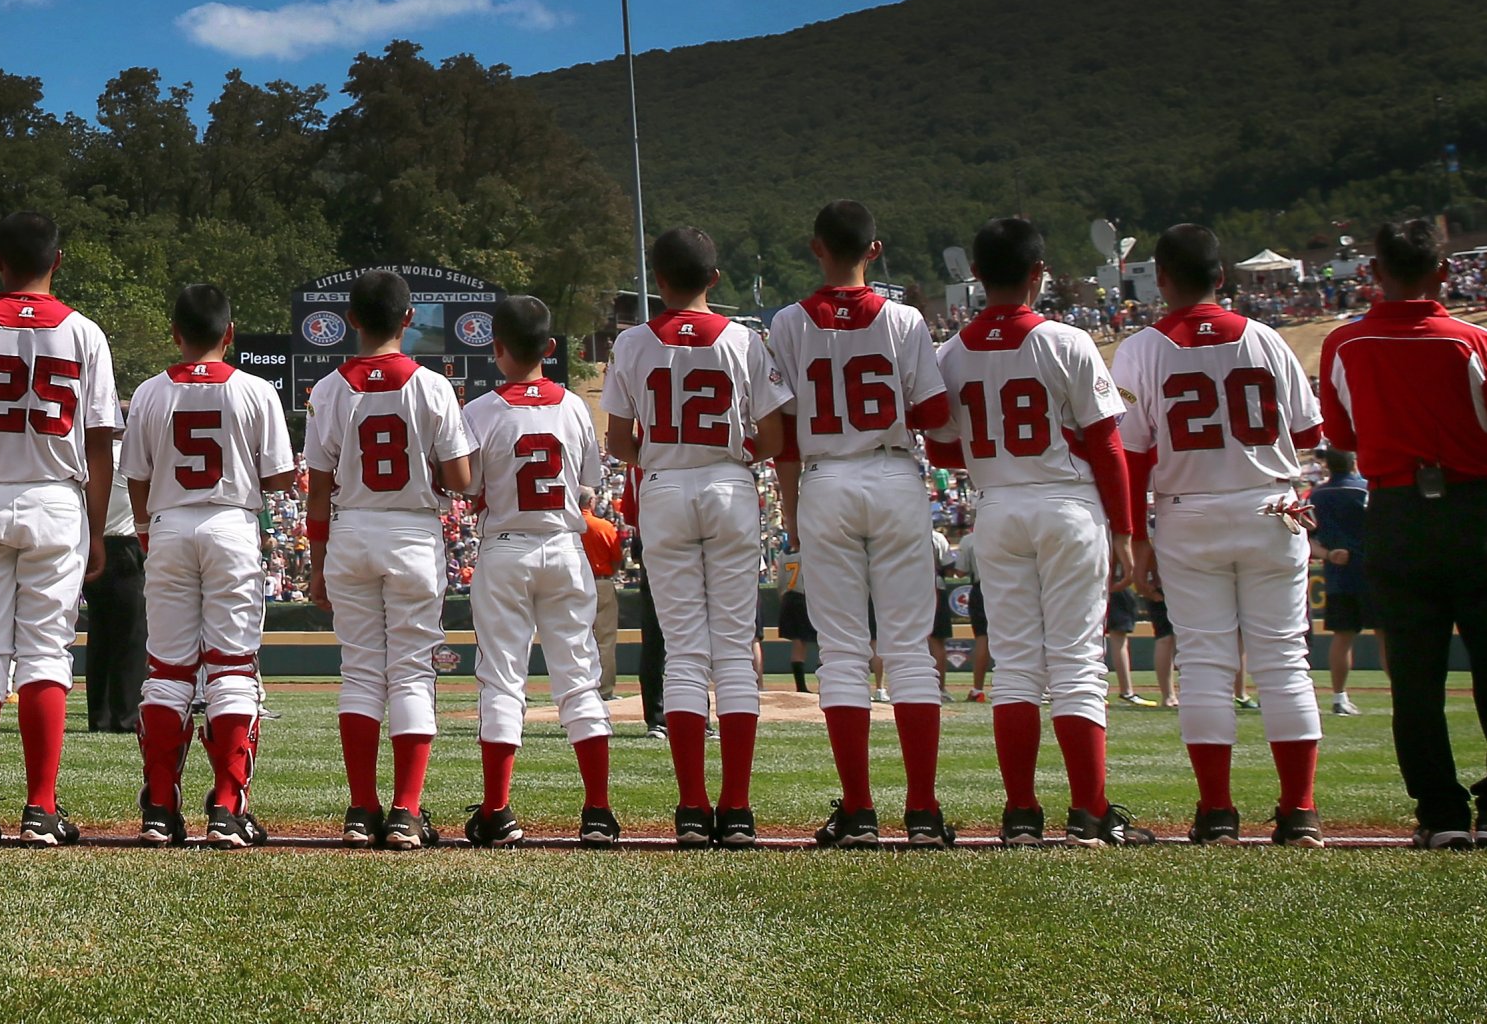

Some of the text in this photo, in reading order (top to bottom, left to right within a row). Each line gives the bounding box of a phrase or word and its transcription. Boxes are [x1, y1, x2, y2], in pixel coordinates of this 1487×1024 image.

[305, 293, 495, 301] EAST NDATIONS
[316, 271, 352, 289] LITTLE
[402, 265, 442, 278] WORLD
[446, 271, 485, 289] SERIES
[240, 352, 286, 364] Please
[807, 354, 897, 435] 16
[647, 368, 733, 447] 12
[959, 378, 1051, 459] 18
[1163, 368, 1279, 451] 20
[172, 411, 223, 490] 5
[358, 414, 410, 492] 8
[514, 434, 565, 511] 2
[785, 562, 800, 591] 7
